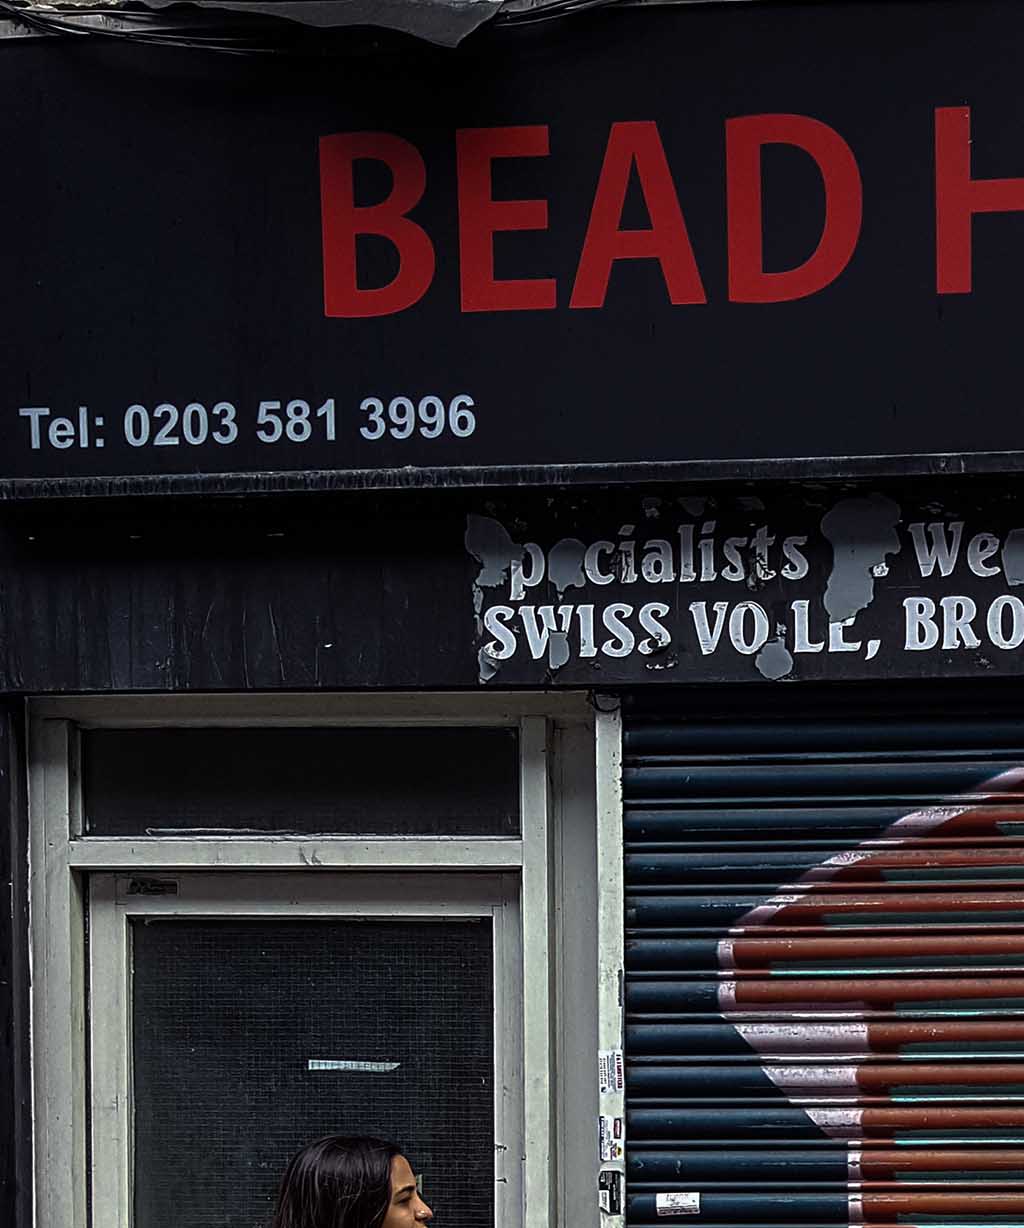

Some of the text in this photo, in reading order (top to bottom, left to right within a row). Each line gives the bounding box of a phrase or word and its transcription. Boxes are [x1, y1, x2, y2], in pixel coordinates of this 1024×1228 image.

[318, 113, 862, 318] BEAD
[19, 394, 476, 449] Tel: 0203 581 3996
[470, 523, 810, 601] pcialists
[483, 602, 672, 660] SWISS
[689, 600, 882, 661] VOLE,
